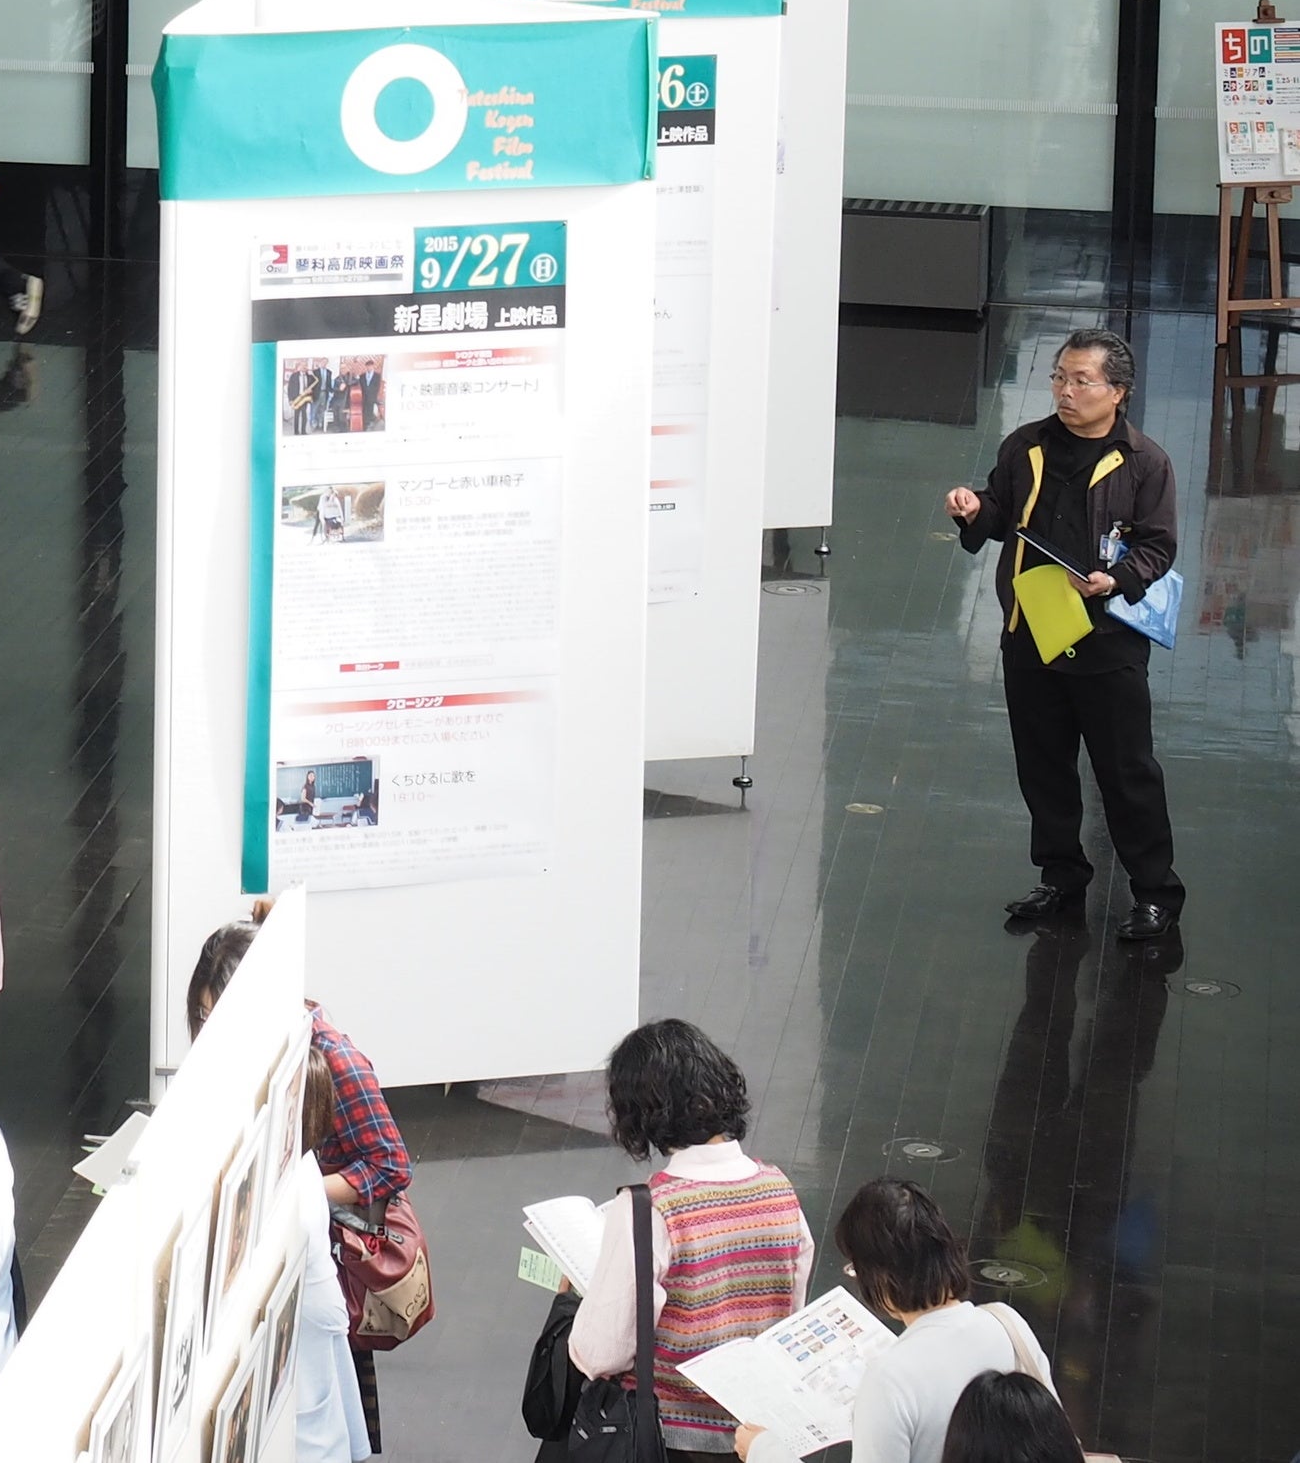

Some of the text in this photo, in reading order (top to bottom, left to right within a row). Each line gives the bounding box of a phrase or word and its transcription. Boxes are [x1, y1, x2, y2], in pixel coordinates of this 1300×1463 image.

[657, 64, 685, 109] 6
[493, 136, 534, 156] Film
[423, 236, 458, 253] 2015
[420, 233, 530, 289] 9/27
[393, 301, 558, 333] 新星劇場 上映作品
